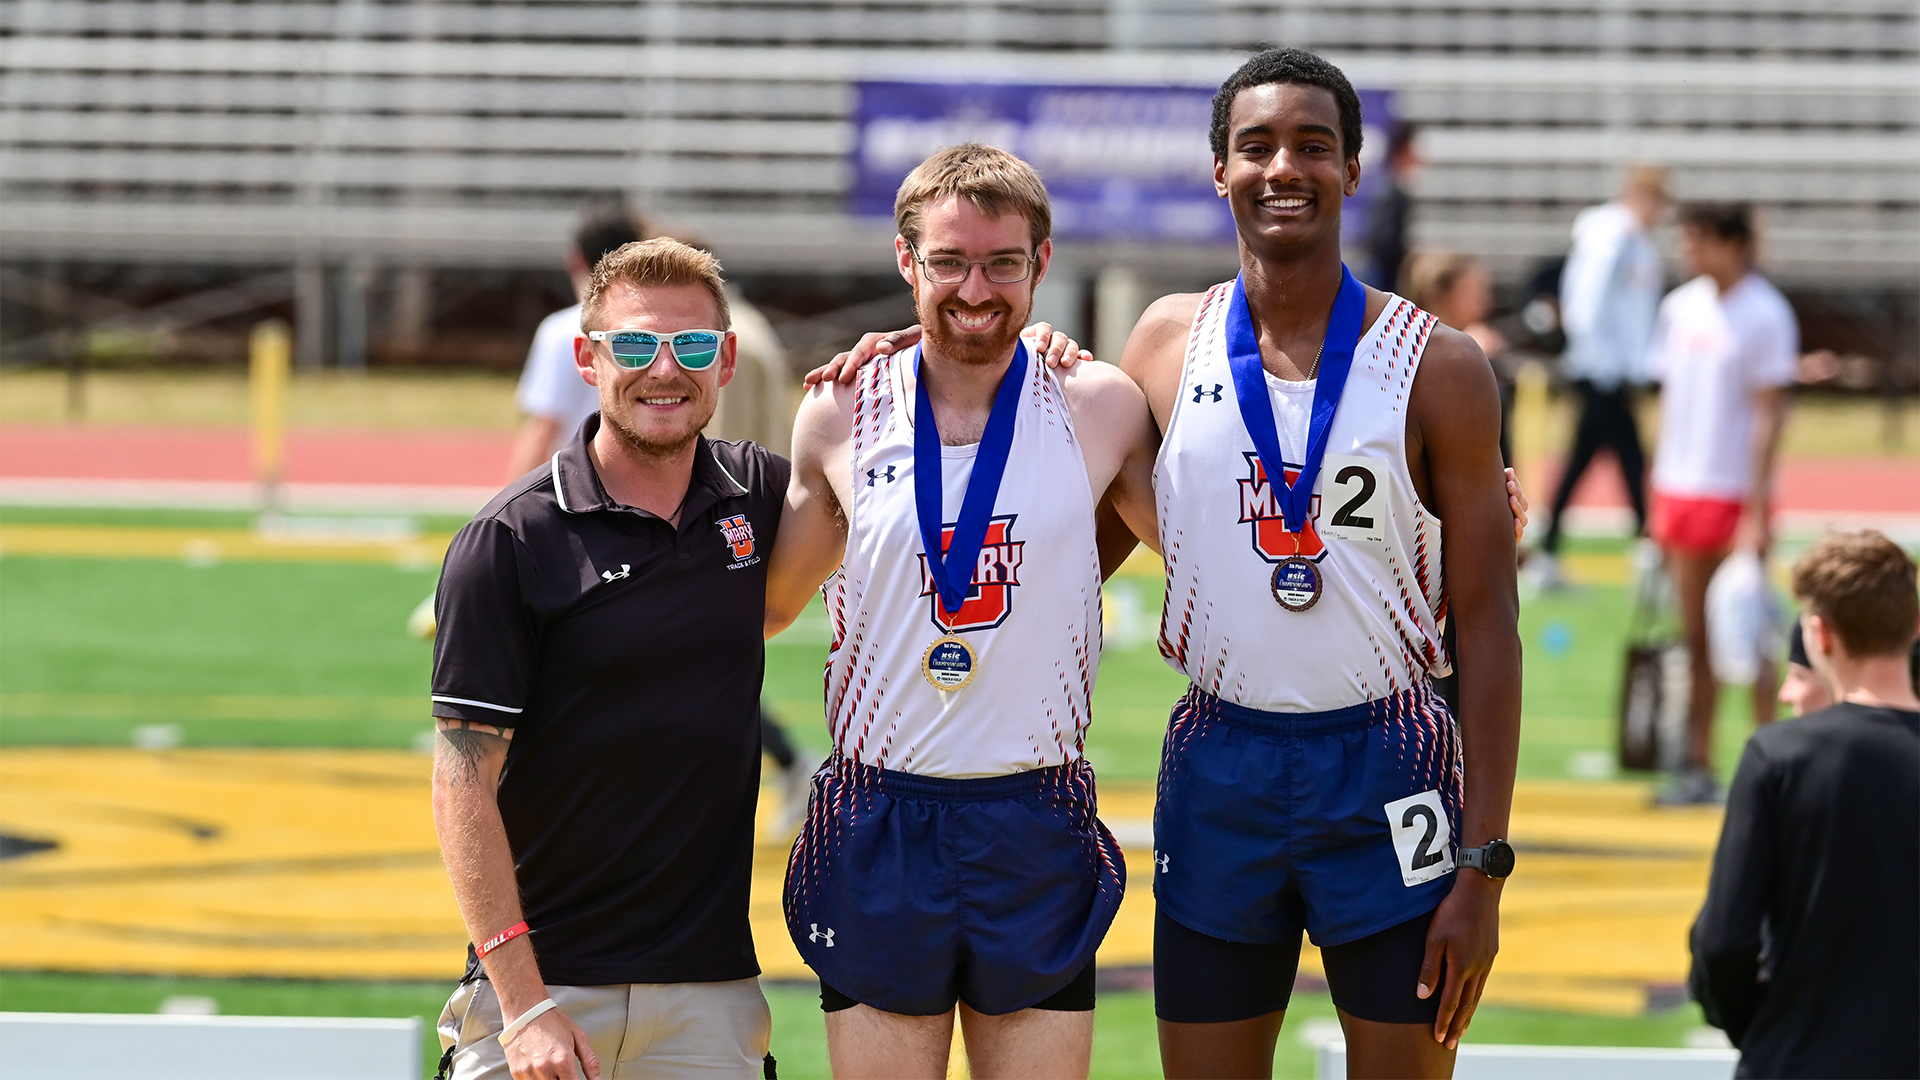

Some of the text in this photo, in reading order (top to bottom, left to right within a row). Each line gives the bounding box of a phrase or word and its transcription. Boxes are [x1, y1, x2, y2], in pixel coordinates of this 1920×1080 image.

[1330, 465, 1377, 529] 2
[721, 523, 754, 546] MARY
[726, 562, 744, 571] TRACK
[1402, 803, 1444, 872] 2
[483, 933, 507, 953] GILL
